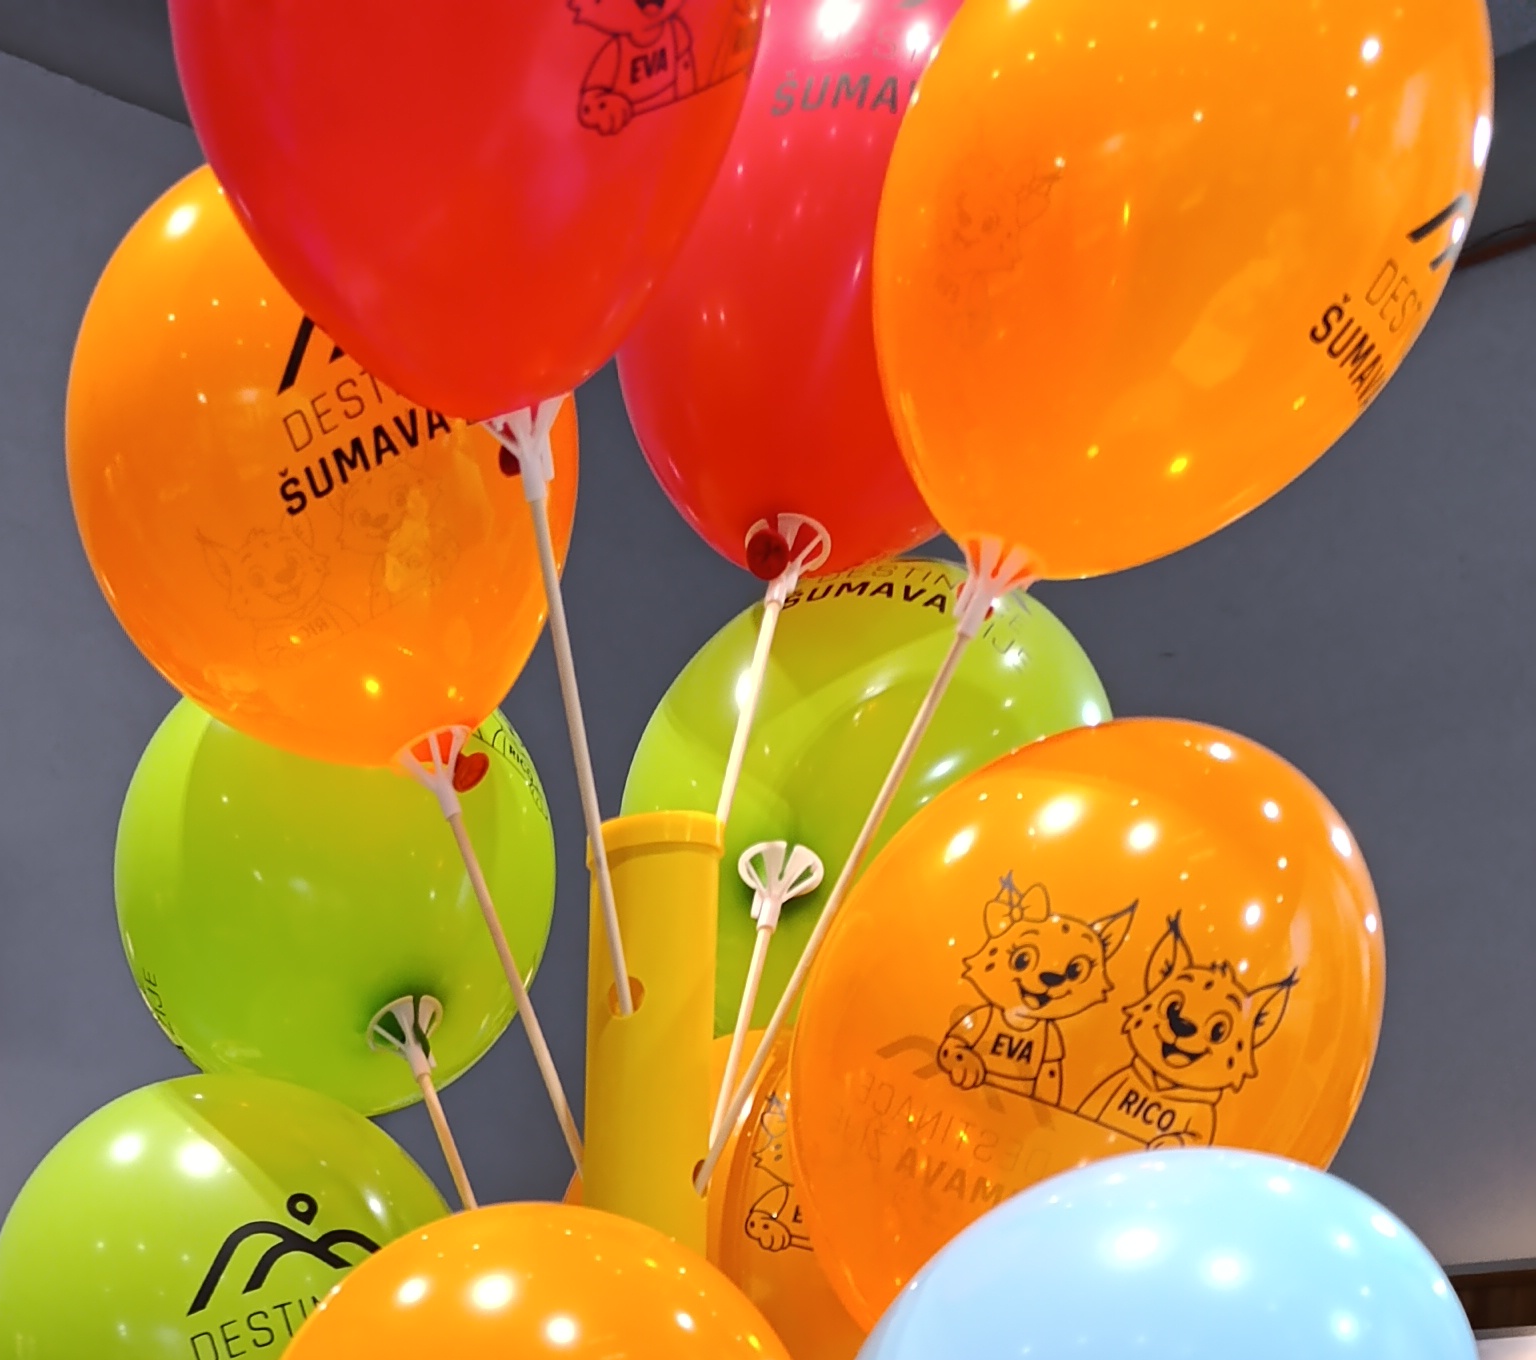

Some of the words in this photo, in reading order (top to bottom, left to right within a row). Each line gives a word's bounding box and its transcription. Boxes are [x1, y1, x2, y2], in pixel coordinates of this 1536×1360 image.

[630, 48, 668, 85] EVA
[770, 69, 917, 117] ŠUMA
[1365, 258, 1423, 333] DES
[278, 407, 452, 516] ŠUMAVA
[781, 580, 948, 614] ŠUMAVA
[990, 1032, 1034, 1065] EVA
[1118, 1088, 1178, 1133] RICO
